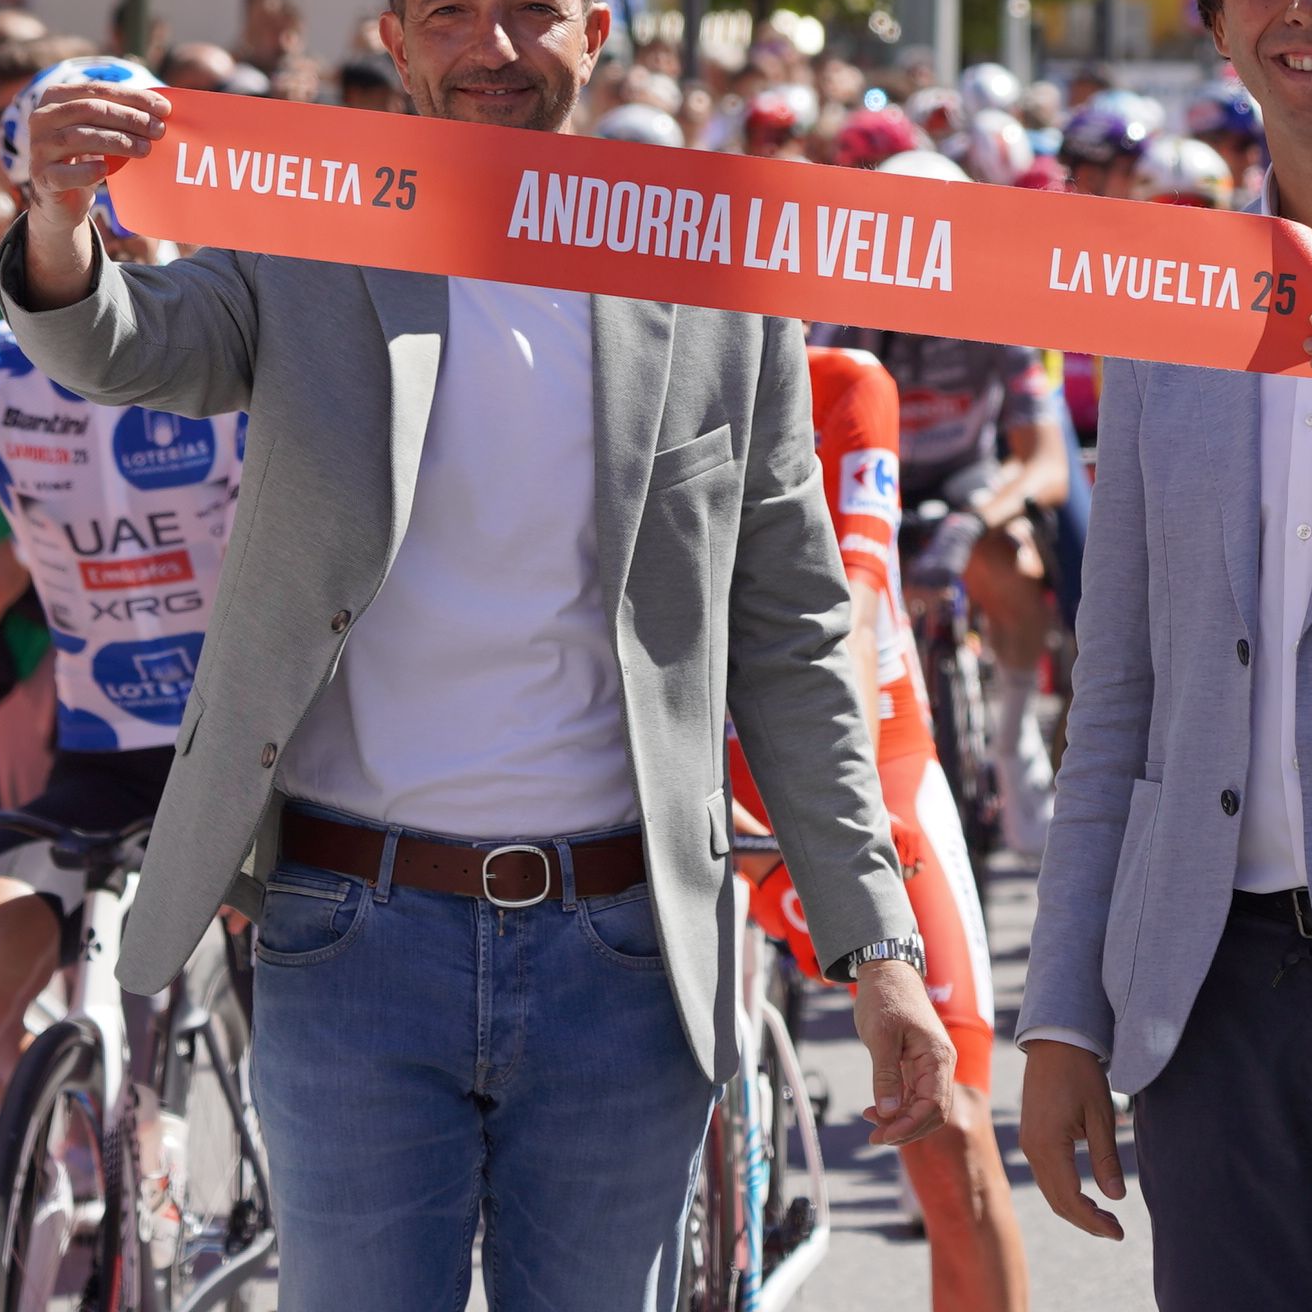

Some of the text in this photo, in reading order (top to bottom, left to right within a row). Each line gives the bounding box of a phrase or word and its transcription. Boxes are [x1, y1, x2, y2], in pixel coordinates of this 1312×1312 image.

[176, 142, 418, 211] LA VUELTA 25
[507, 169, 953, 292] ANDORRA LA VELLA
[1049, 248, 1297, 316] LA VUELTA 25
[1, 406, 88, 435] Santini
[74, 449, 88, 466] 25
[63, 511, 185, 556] UAE
[90, 589, 204, 622] XRG
